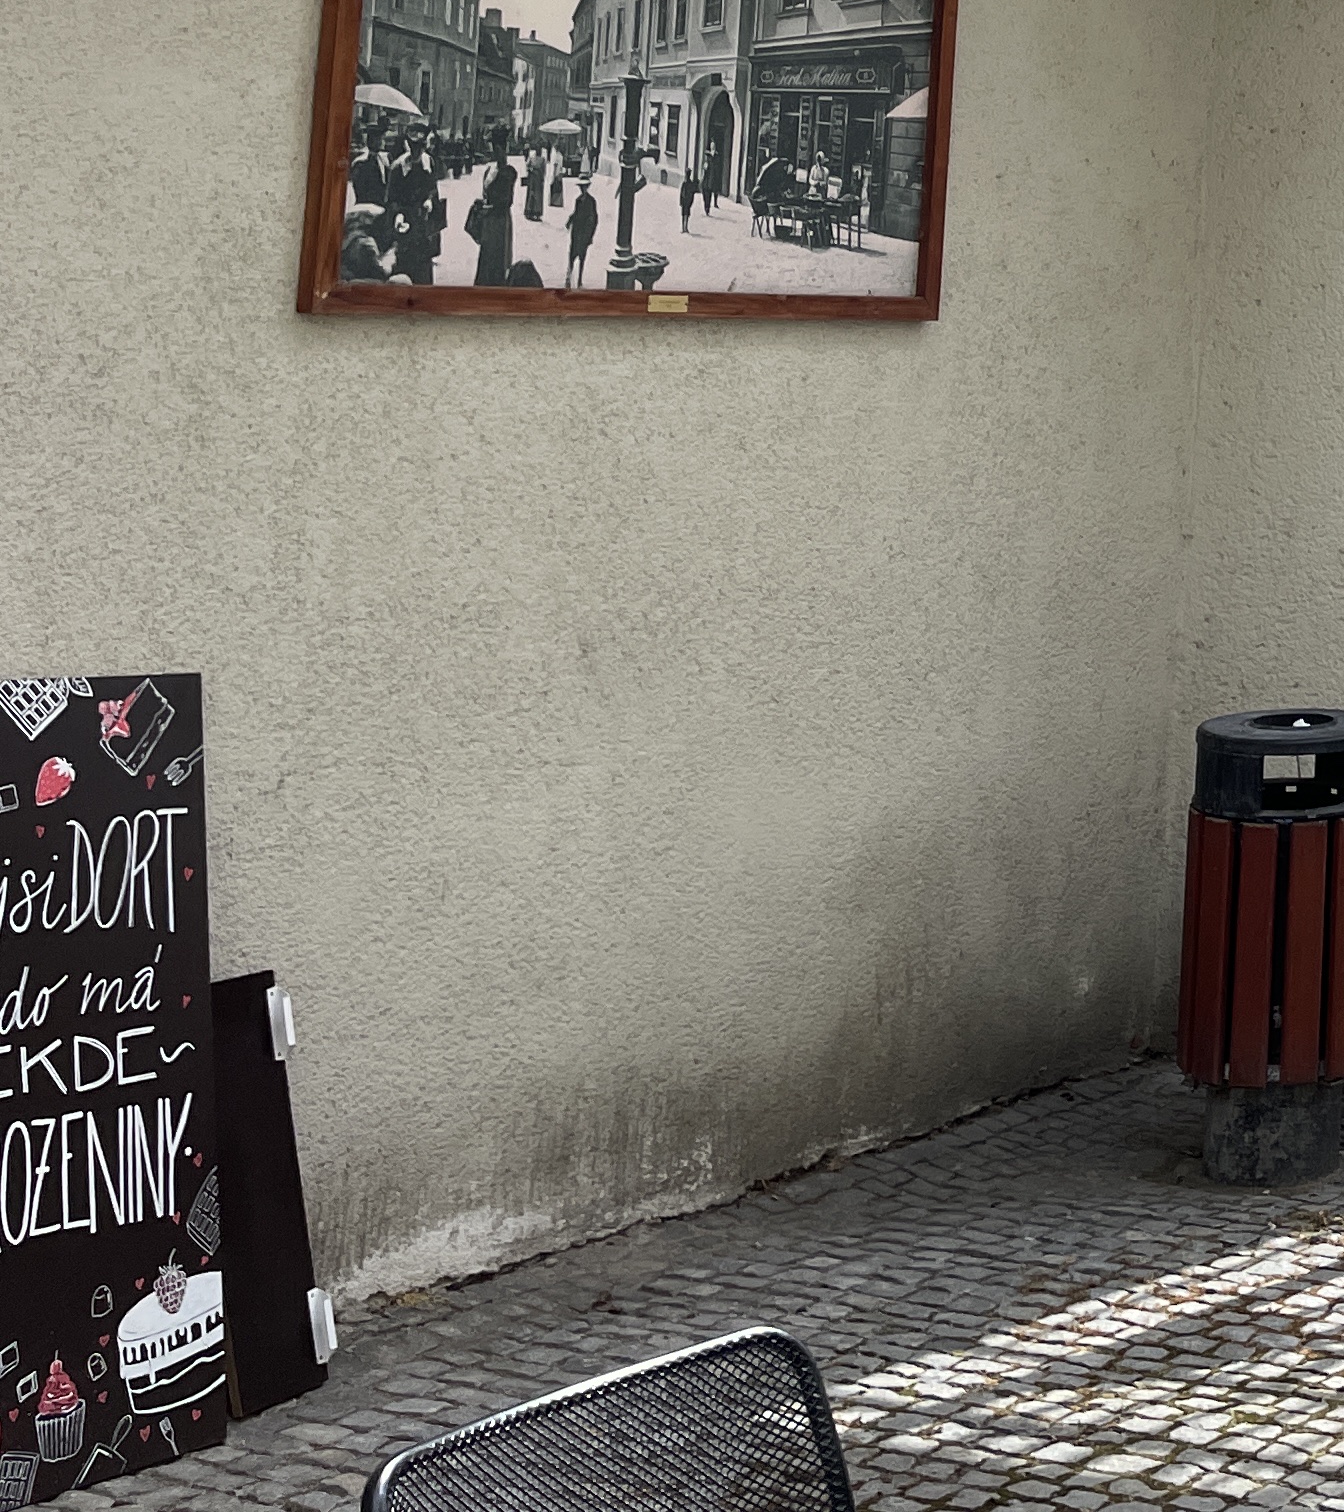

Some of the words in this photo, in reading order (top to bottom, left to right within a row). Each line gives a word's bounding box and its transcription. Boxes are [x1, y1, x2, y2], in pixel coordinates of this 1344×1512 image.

[63, 807, 189, 934] DORT
[81, 943, 162, 1015] má
[0, 1025, 158, 1100] KDE
